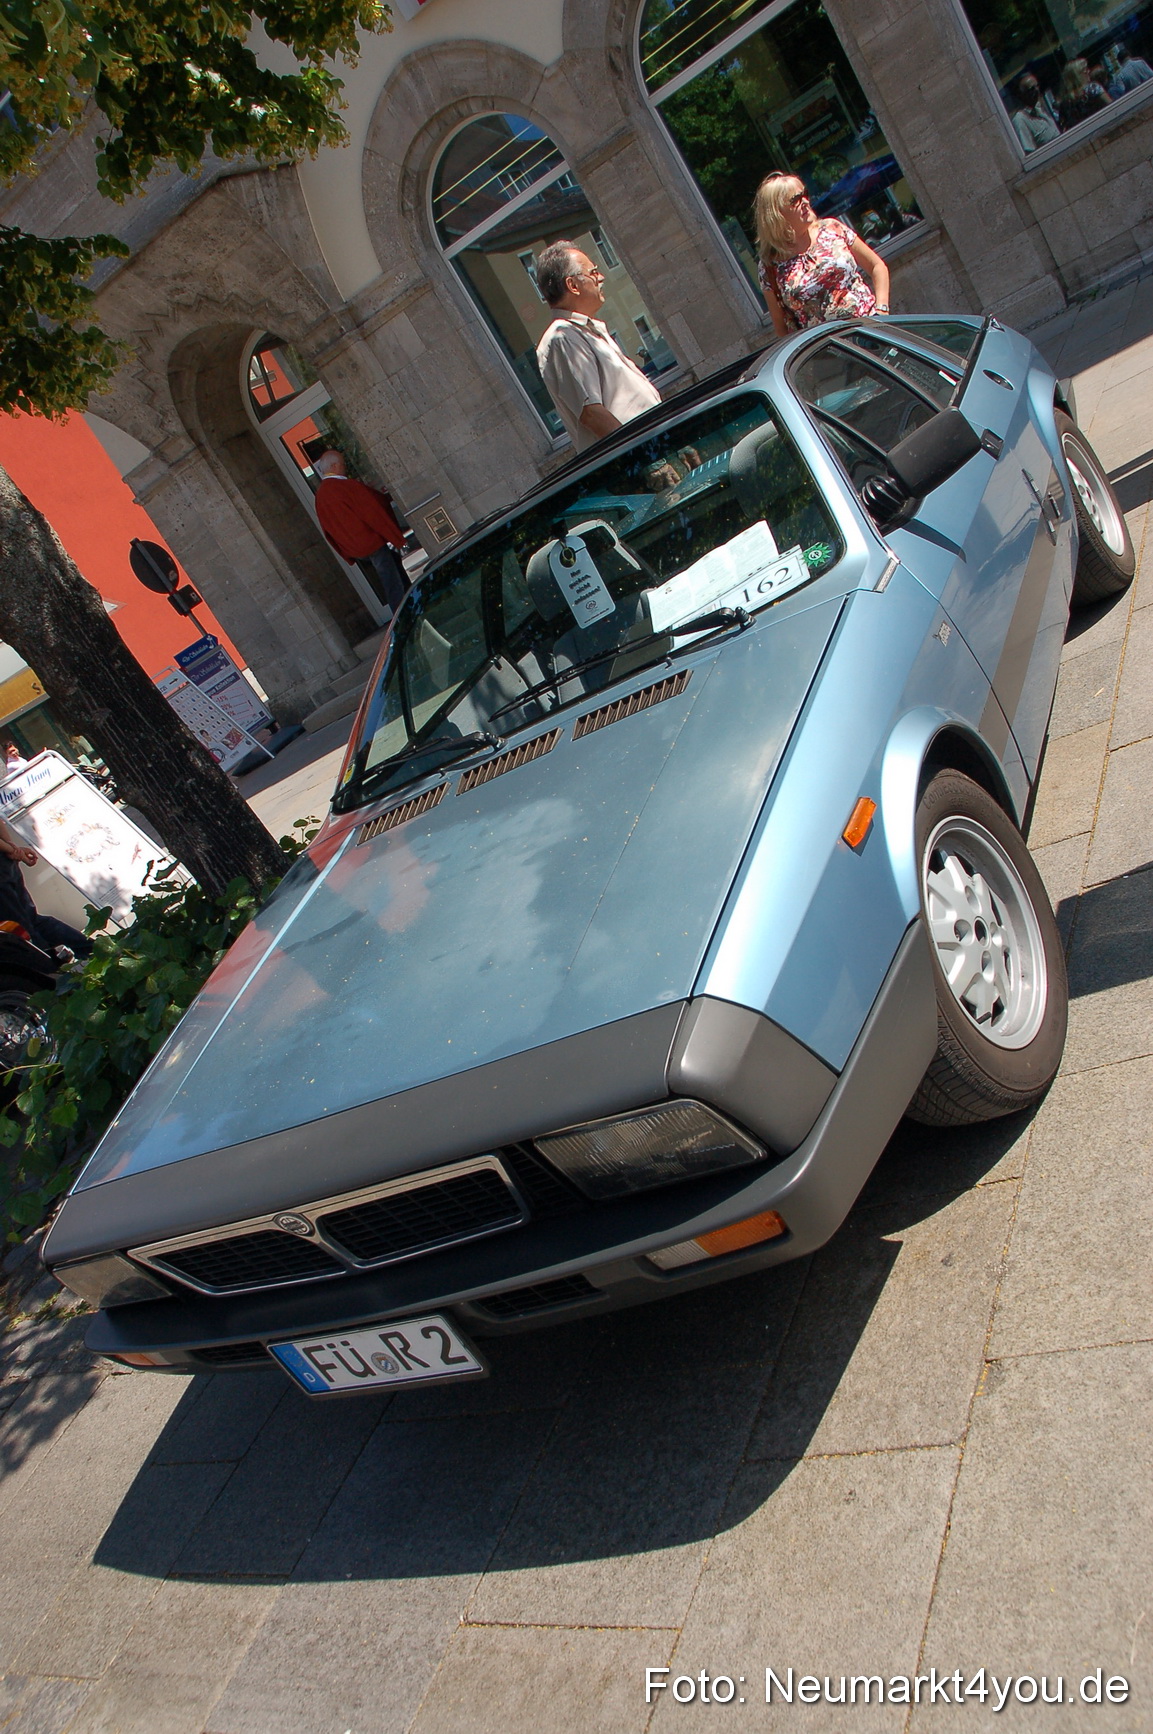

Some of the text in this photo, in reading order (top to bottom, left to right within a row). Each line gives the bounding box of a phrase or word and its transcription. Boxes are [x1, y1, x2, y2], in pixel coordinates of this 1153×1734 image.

[742, 566, 793, 604] 162
[302, 1325, 469, 1383] FÜ R 2
